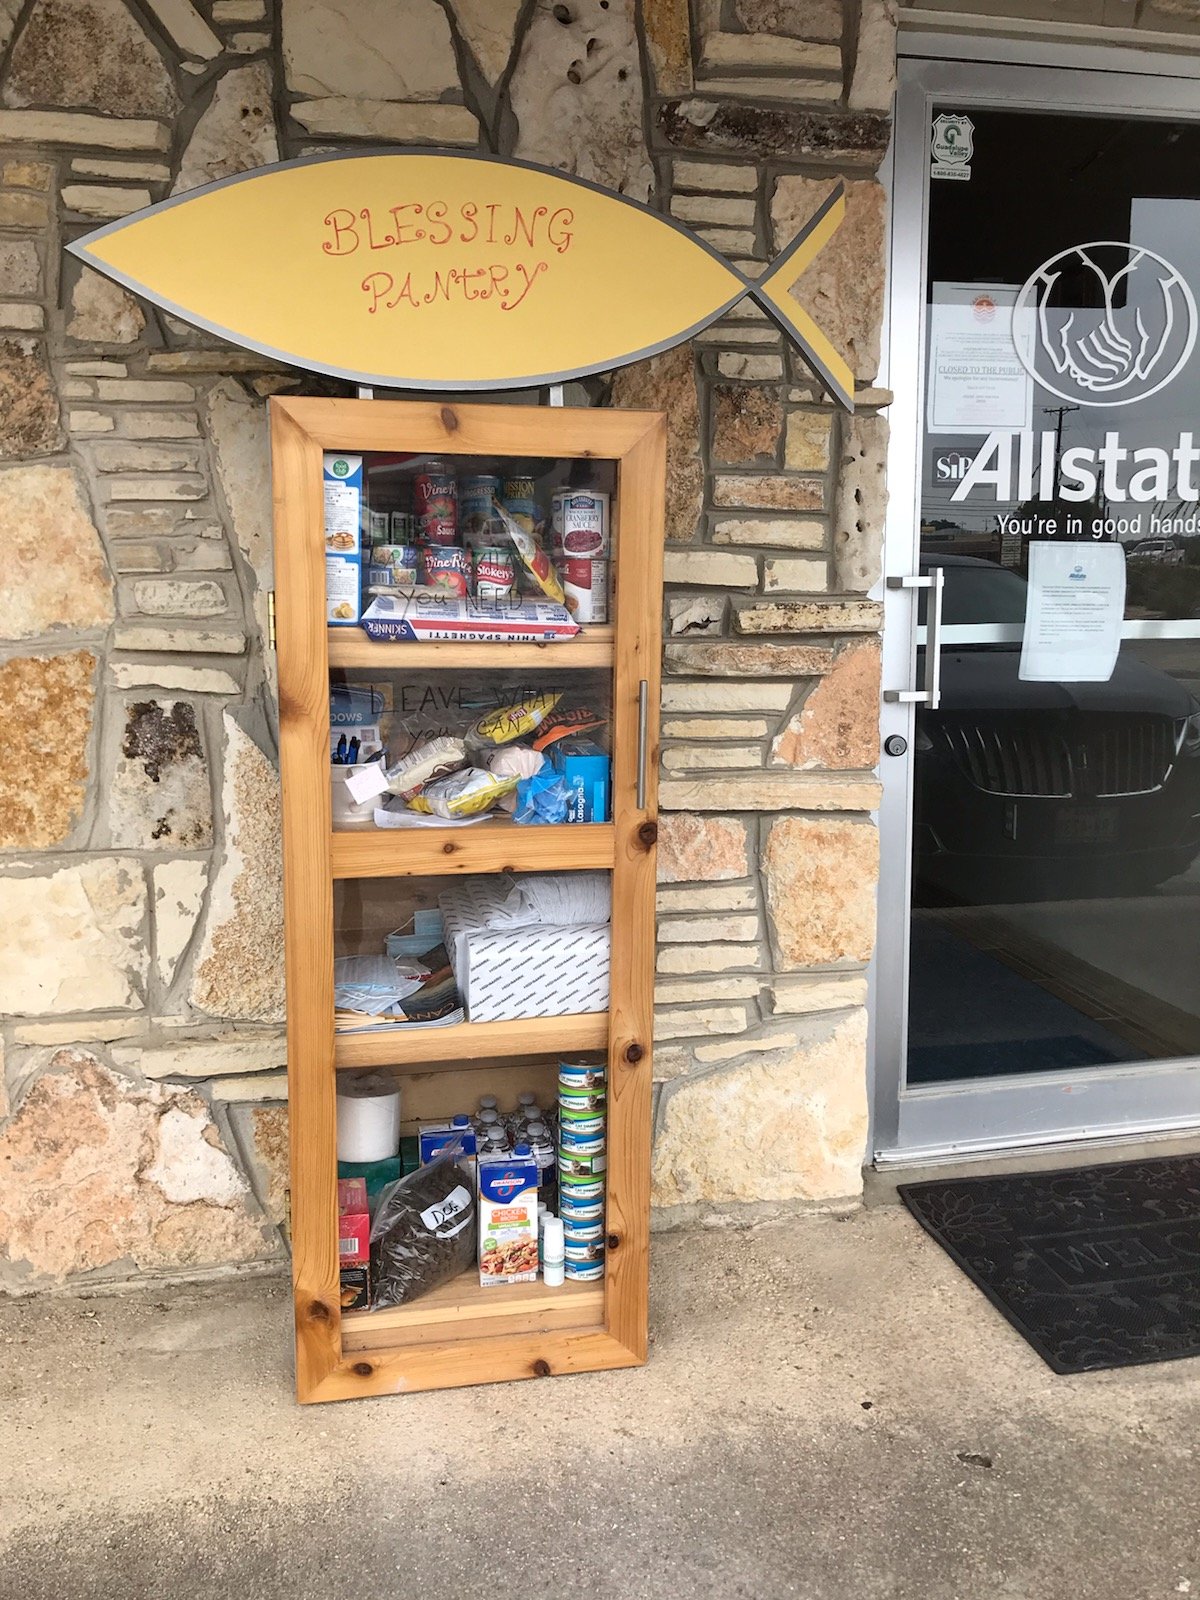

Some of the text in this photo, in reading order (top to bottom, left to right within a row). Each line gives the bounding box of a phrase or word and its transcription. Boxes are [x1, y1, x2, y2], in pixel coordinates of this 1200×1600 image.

[322, 200, 574, 255] BLESSING
[938, 365, 968, 374] CLOSED
[970, 366, 980, 374] TO
[421, 482, 448, 499] Vine
[997, 513, 1057, 535] You're
[1066, 513, 1083, 534] in
[1092, 513, 1141, 538] good
[466, 587, 523, 612] NEED
[367, 622, 407, 637] SKINNER
[429, 631, 501, 641] SPAGHETTI
[370, 684, 565, 715] LEAVE WHAT
[476, 717, 521, 736] CAN
[576, 787, 586, 822] Lasagna
[492, 1207, 527, 1217] CHICKEN
